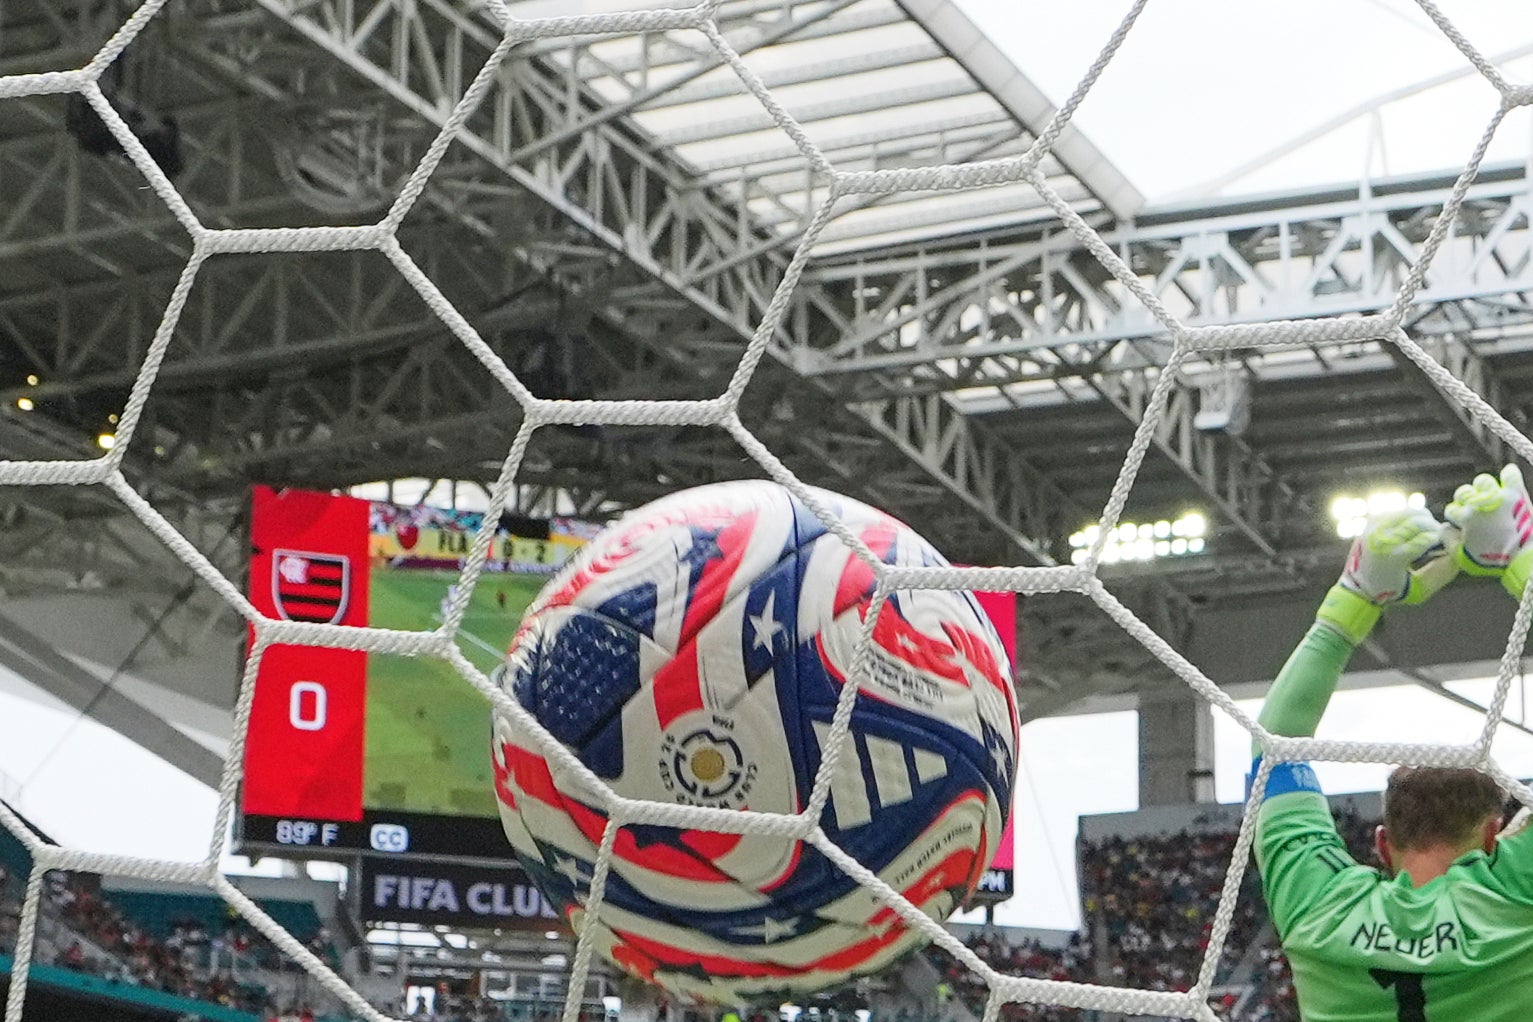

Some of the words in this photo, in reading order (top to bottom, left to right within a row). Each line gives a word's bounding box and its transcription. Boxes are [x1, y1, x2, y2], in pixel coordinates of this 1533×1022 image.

[289, 681, 328, 731] 0
[373, 874, 460, 912] FIFA
[1350, 919, 1458, 960] NEUER
